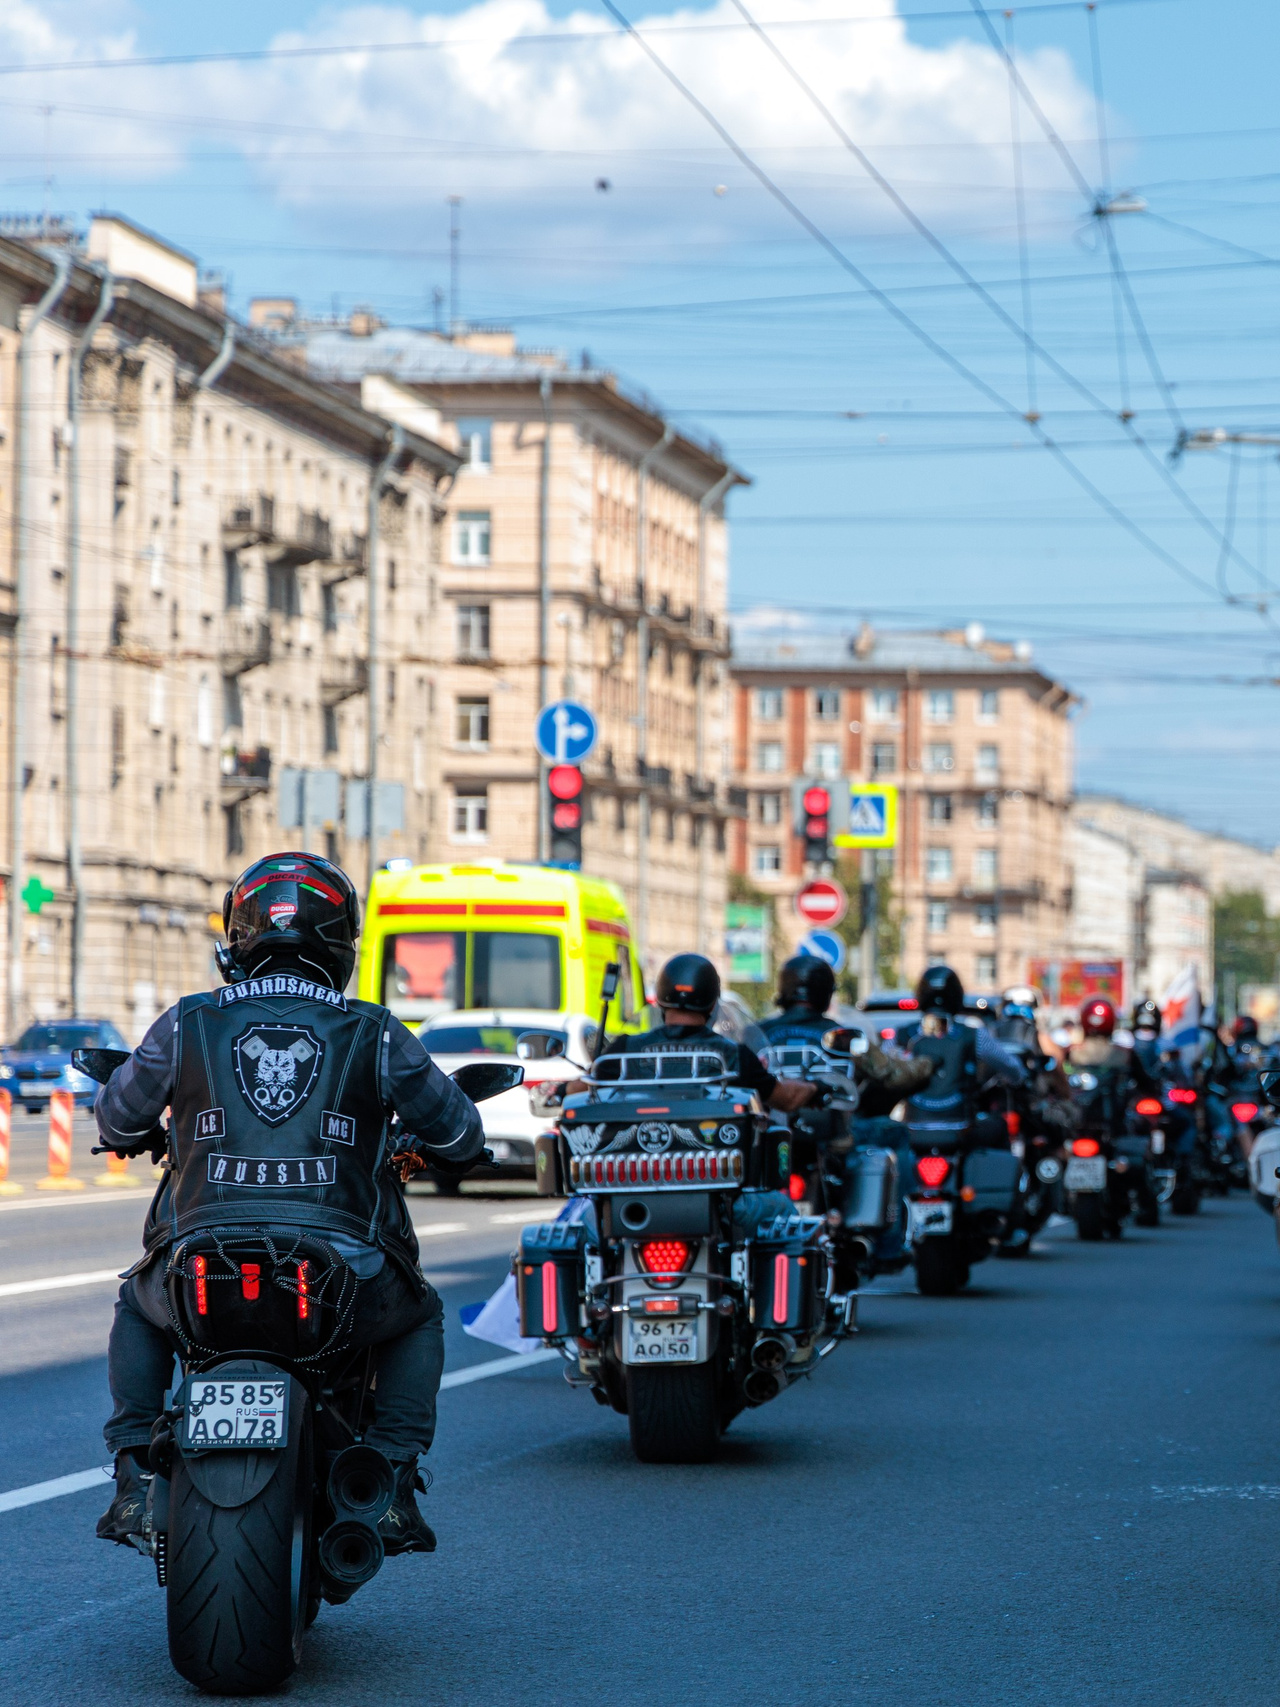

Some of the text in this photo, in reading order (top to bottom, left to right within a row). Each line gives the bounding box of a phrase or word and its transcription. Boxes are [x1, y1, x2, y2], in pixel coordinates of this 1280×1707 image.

[267, 873, 304, 881] DUCATI
[223, 976, 341, 1005] GUARDSMEN
[201, 1113, 217, 1135] LE
[327, 1116, 349, 1139] MC
[213, 1157, 328, 1185] RUSSIA
[667, 1344, 689, 1356] 50
[236, 1408, 259, 1416] RUS
[243, 1418, 276, 1439] 78
